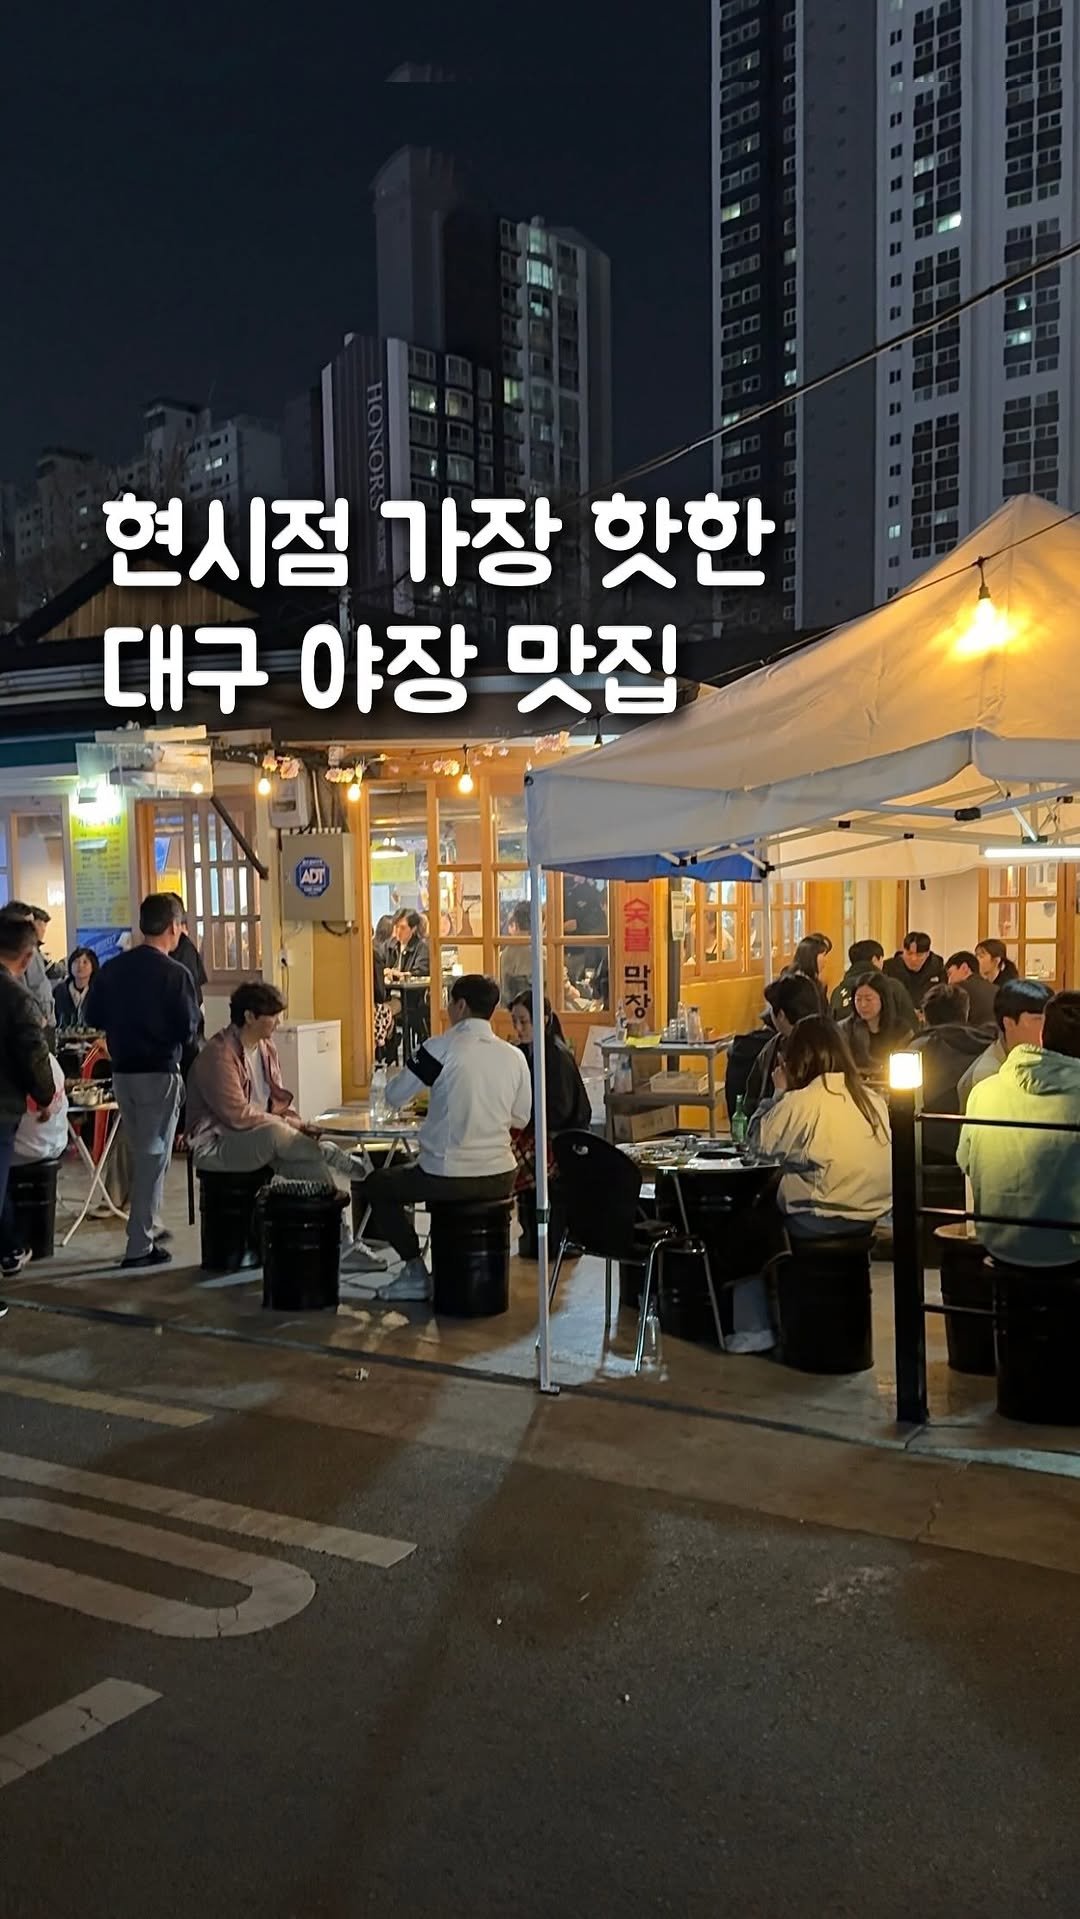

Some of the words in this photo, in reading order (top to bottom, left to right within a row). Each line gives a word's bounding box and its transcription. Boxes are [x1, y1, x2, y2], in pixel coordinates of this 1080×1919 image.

[366, 381, 386, 512] HONORS
[301, 868, 325, 884] ADT
[624, 964, 651, 1019] 막창
